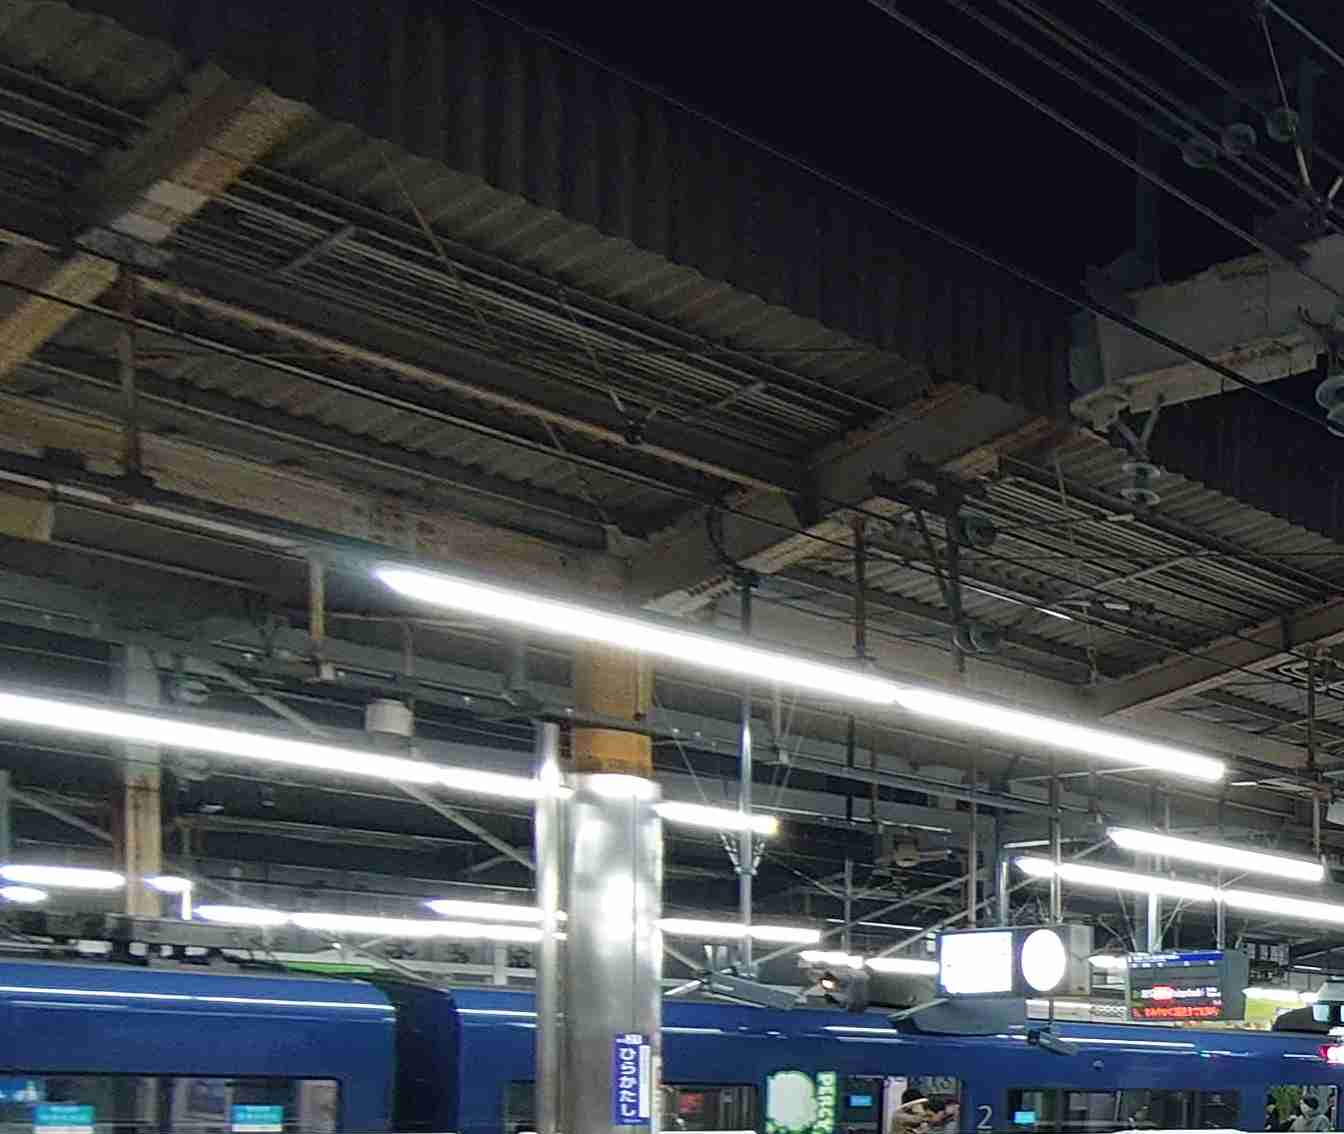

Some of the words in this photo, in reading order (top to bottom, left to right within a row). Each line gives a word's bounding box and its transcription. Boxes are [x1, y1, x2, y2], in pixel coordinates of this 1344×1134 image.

[618, 1047, 637, 1117] ひらかたし
[976, 1104, 993, 1130] 2
